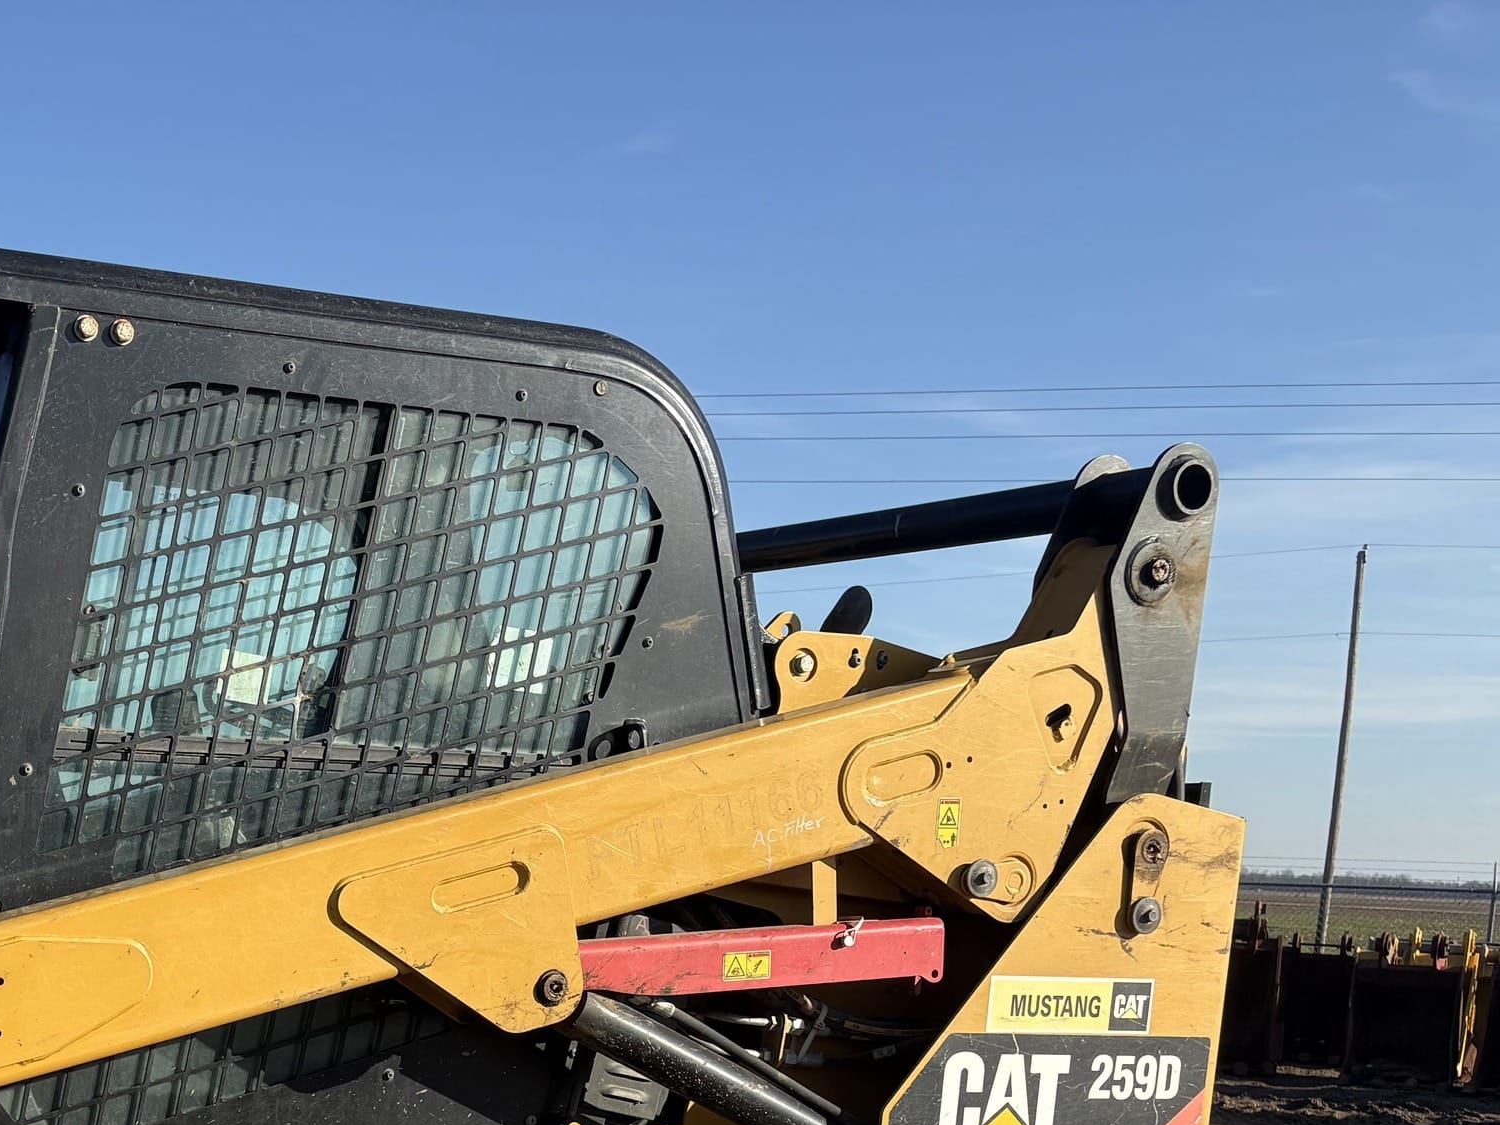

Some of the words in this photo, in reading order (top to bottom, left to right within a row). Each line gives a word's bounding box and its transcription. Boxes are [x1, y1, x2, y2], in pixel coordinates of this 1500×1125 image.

[1010, 994, 1101, 1018] MUSTANG
[1113, 994, 1149, 1019] CAT
[1088, 1054, 1182, 1101] 259D
